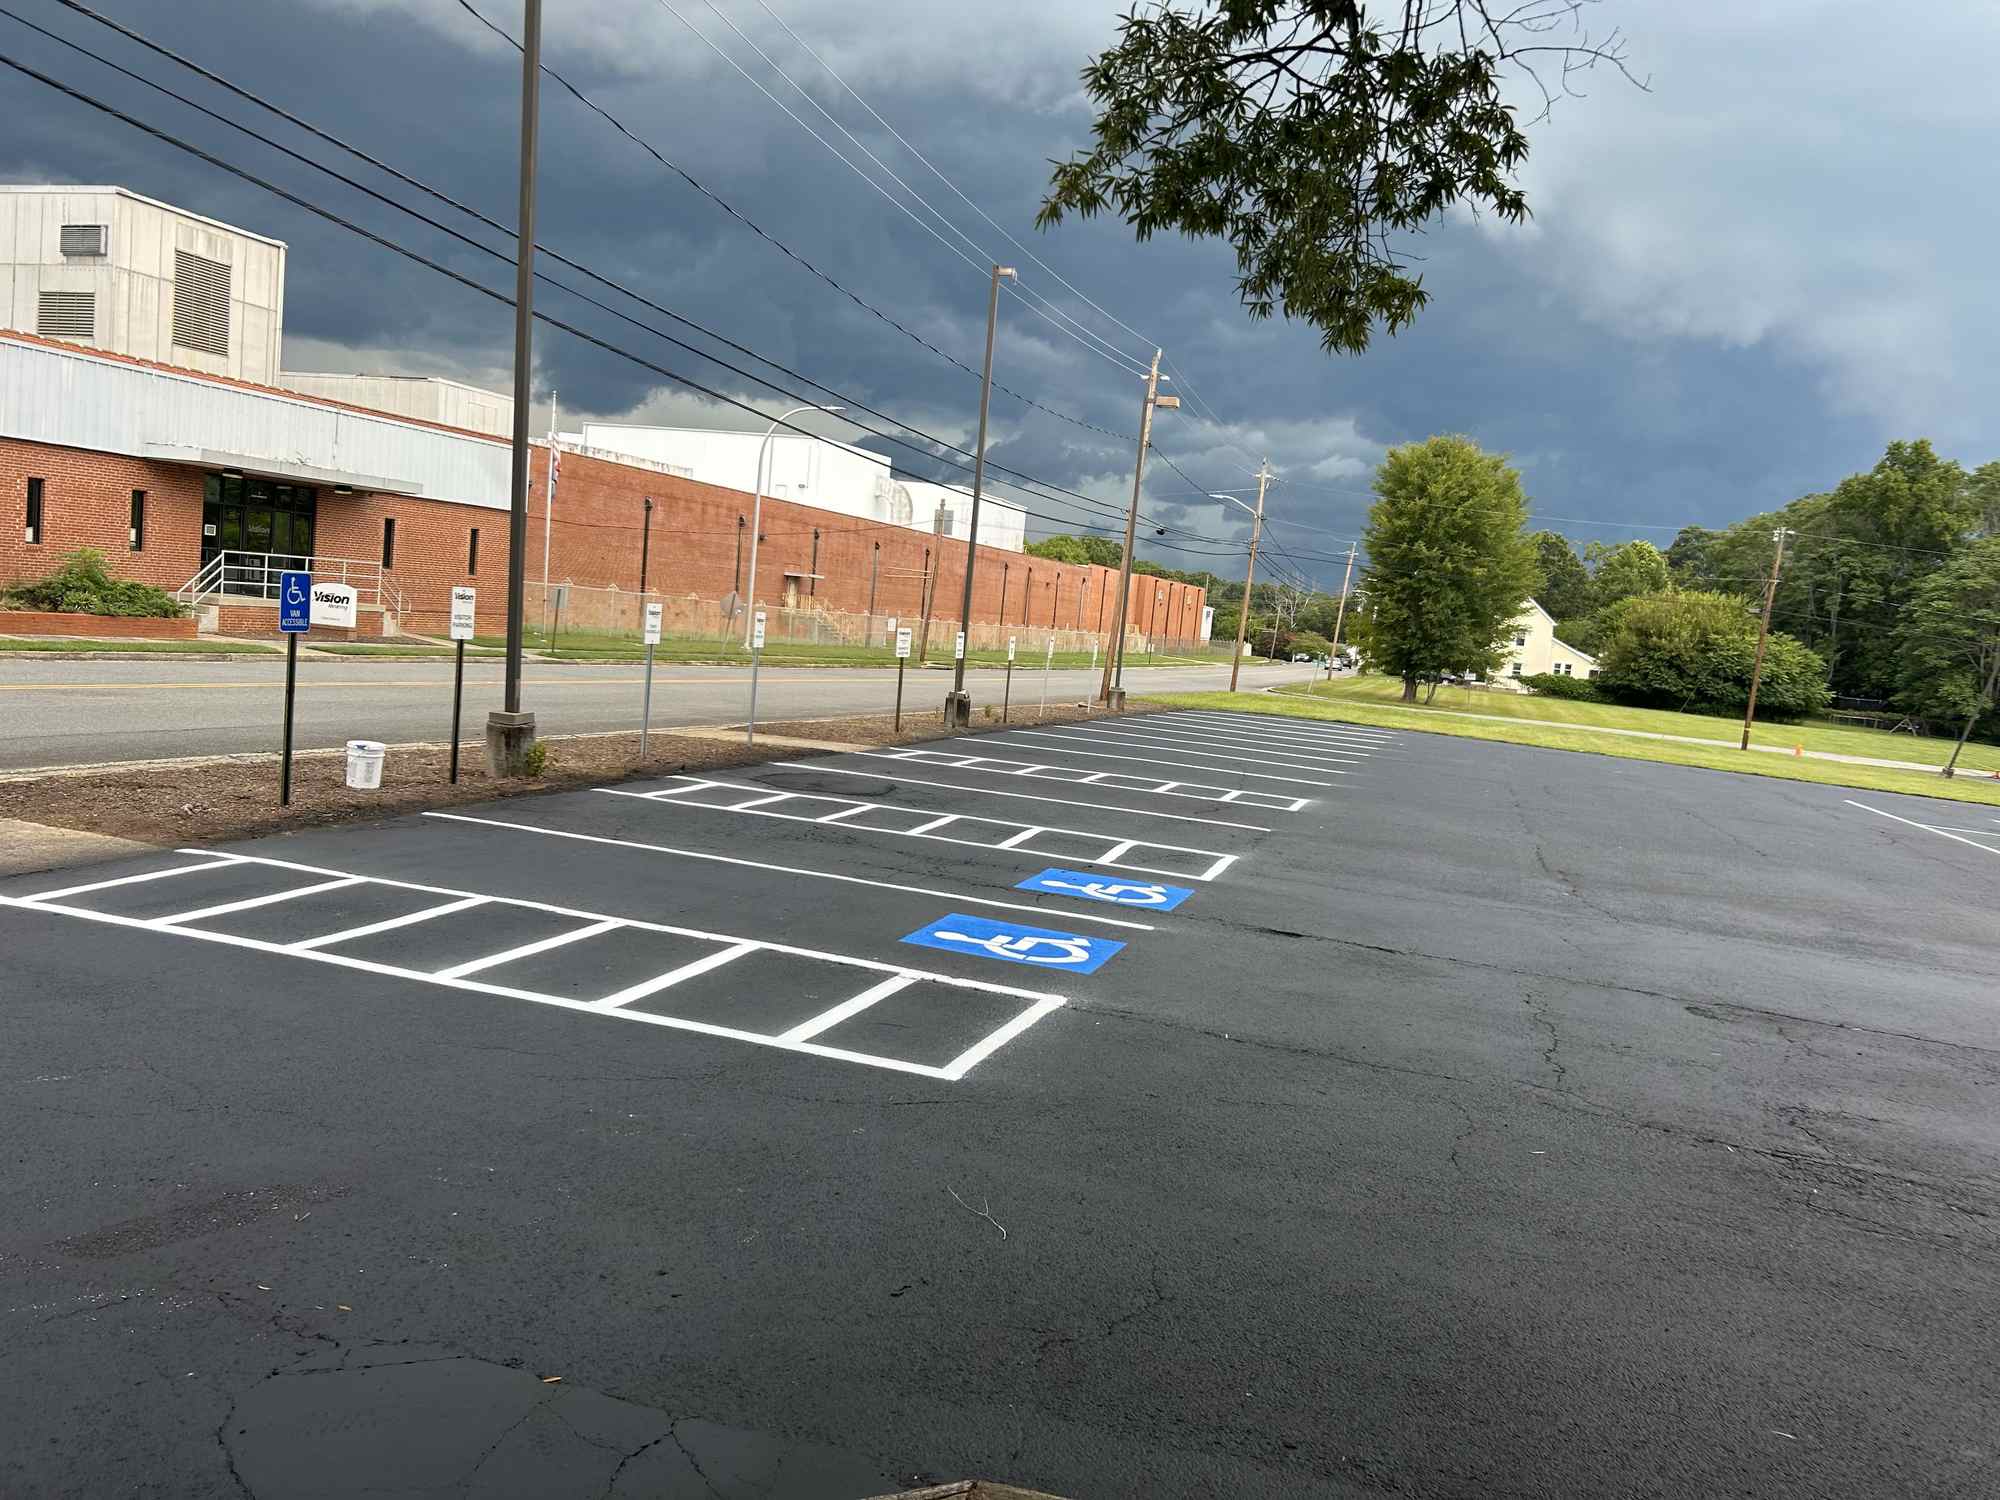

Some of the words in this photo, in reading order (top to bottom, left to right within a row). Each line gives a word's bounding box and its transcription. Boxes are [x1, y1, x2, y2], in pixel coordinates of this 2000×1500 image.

[314, 591, 350, 605] Vision
[455, 592, 473, 600] Vision
[282, 618, 308, 626] ACCESSIBLE
